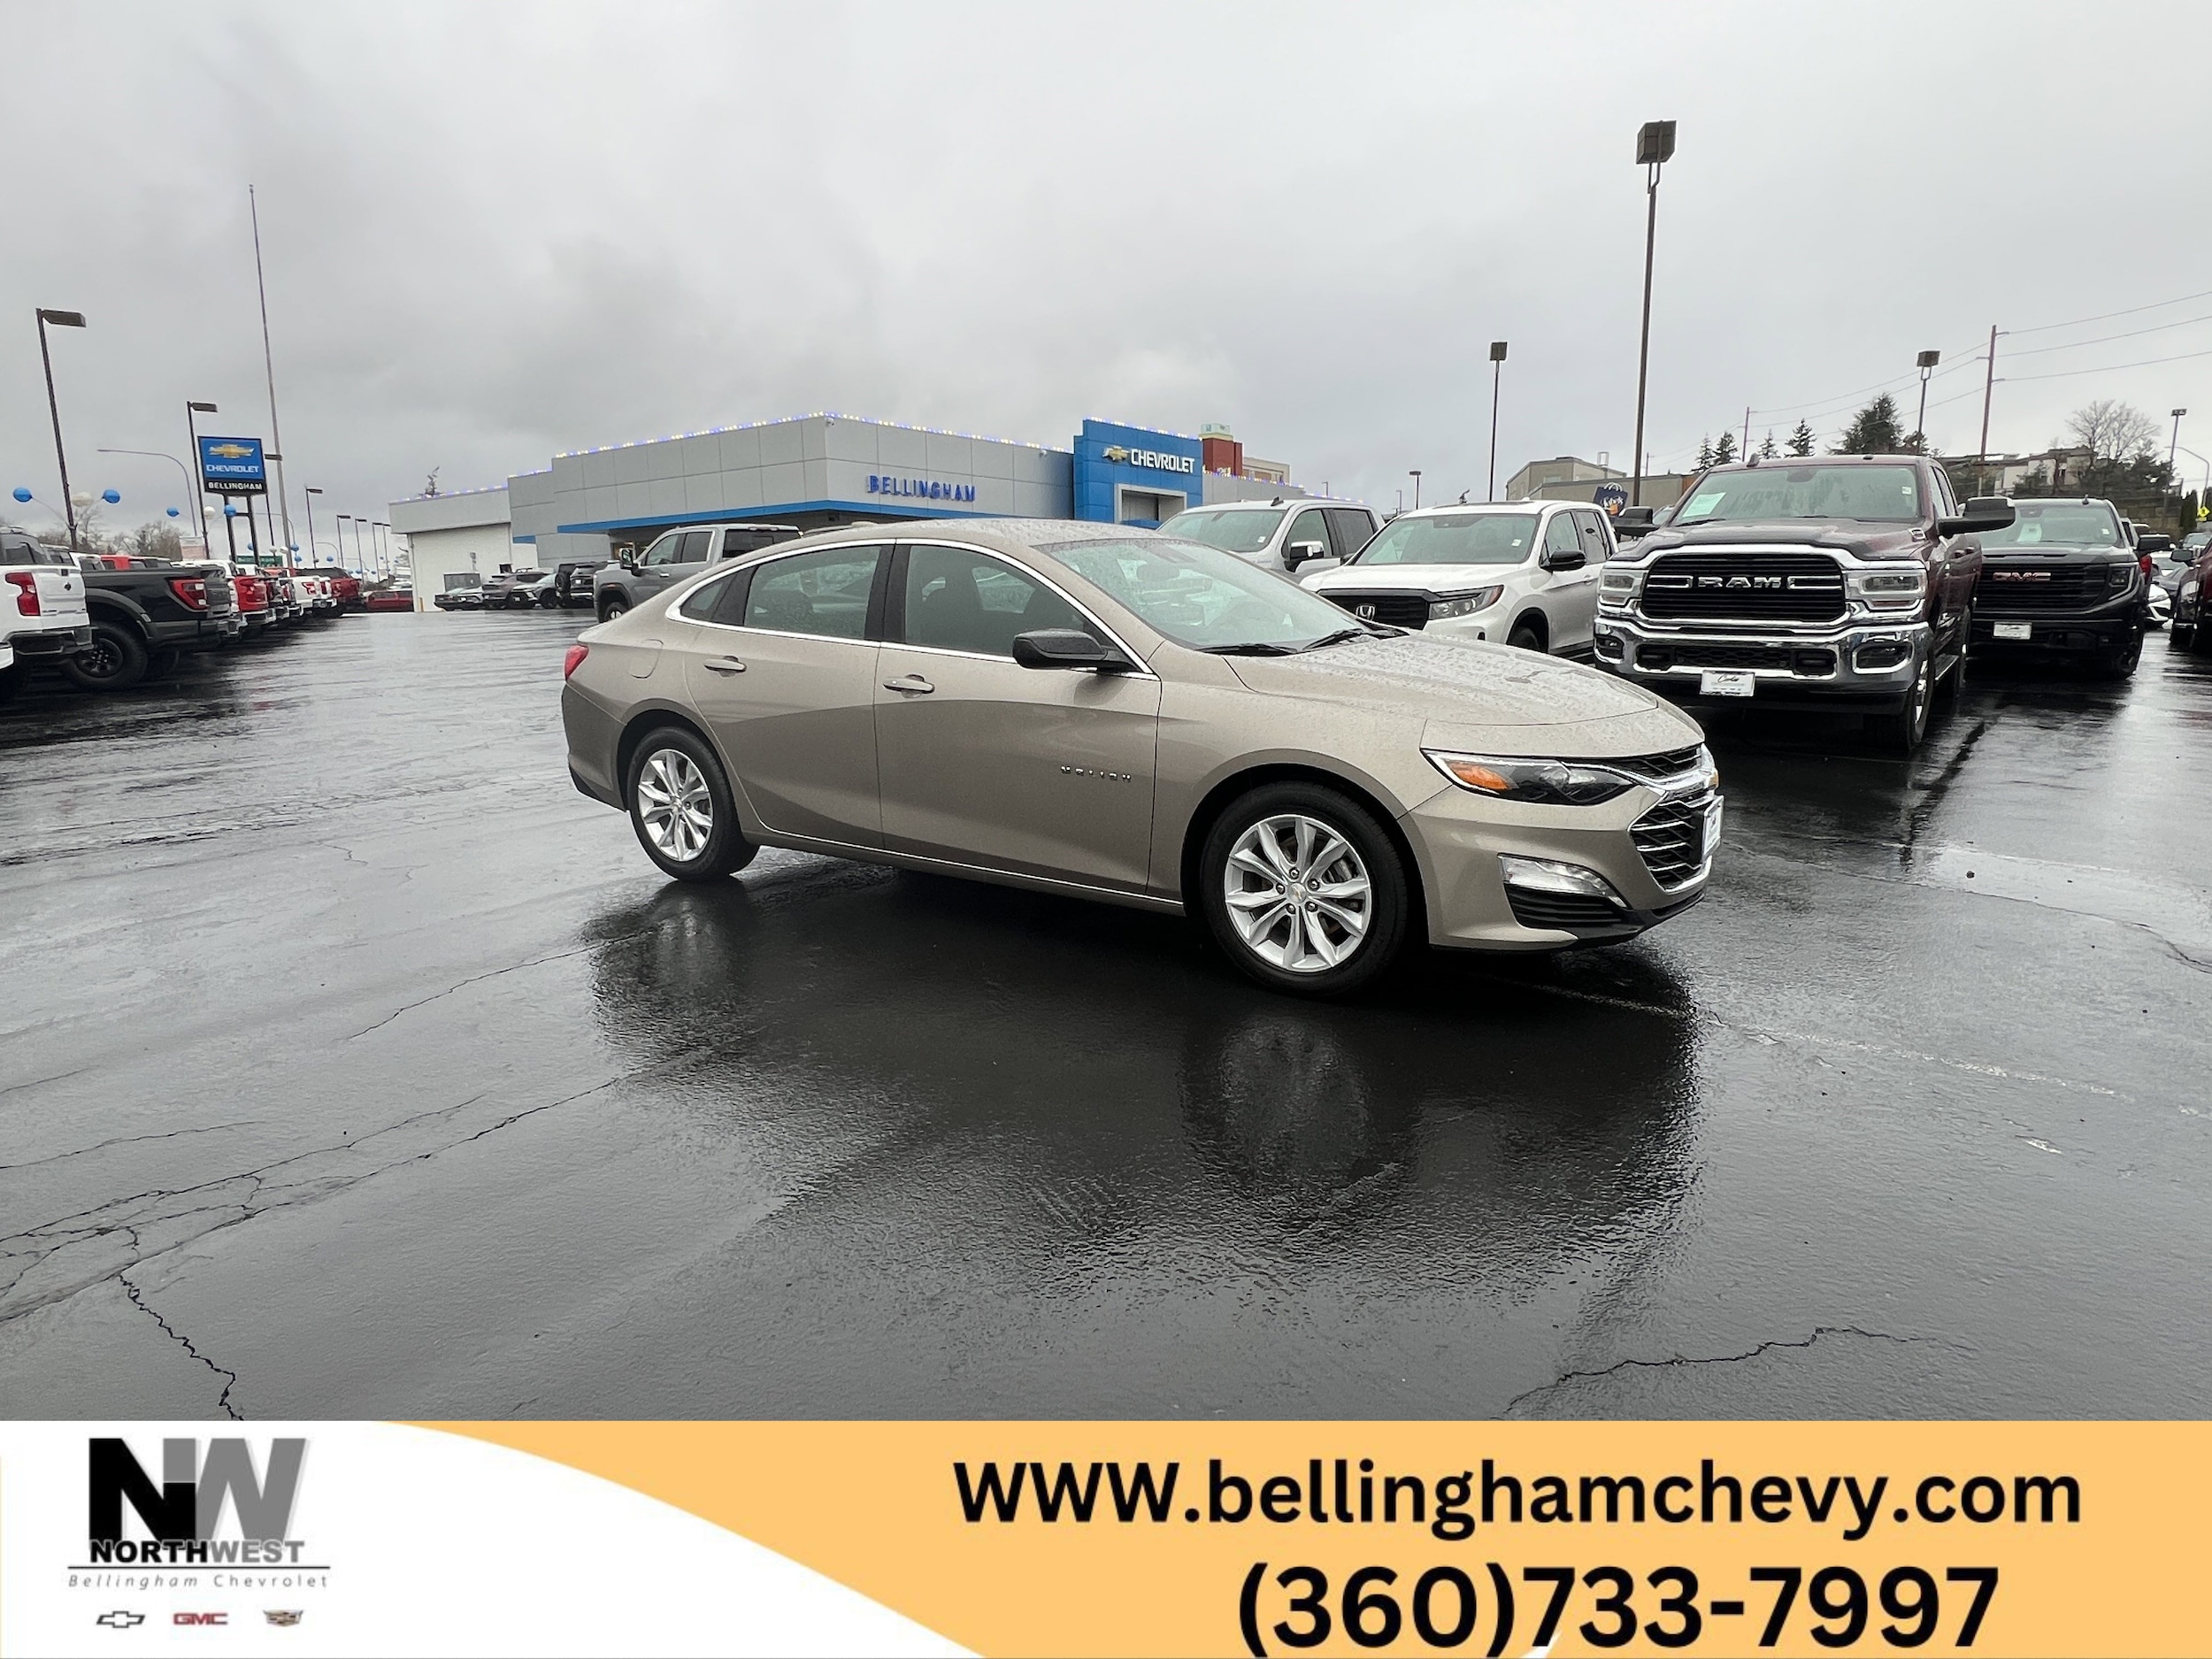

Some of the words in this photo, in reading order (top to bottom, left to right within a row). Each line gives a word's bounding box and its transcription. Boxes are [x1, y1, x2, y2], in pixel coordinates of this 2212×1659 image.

[1131, 449, 1194, 473] CHEVROLET
[867, 475, 975, 502] BELLINGHAM
[1698, 577, 1781, 588] RAM
[1993, 572, 2051, 581] GMC
